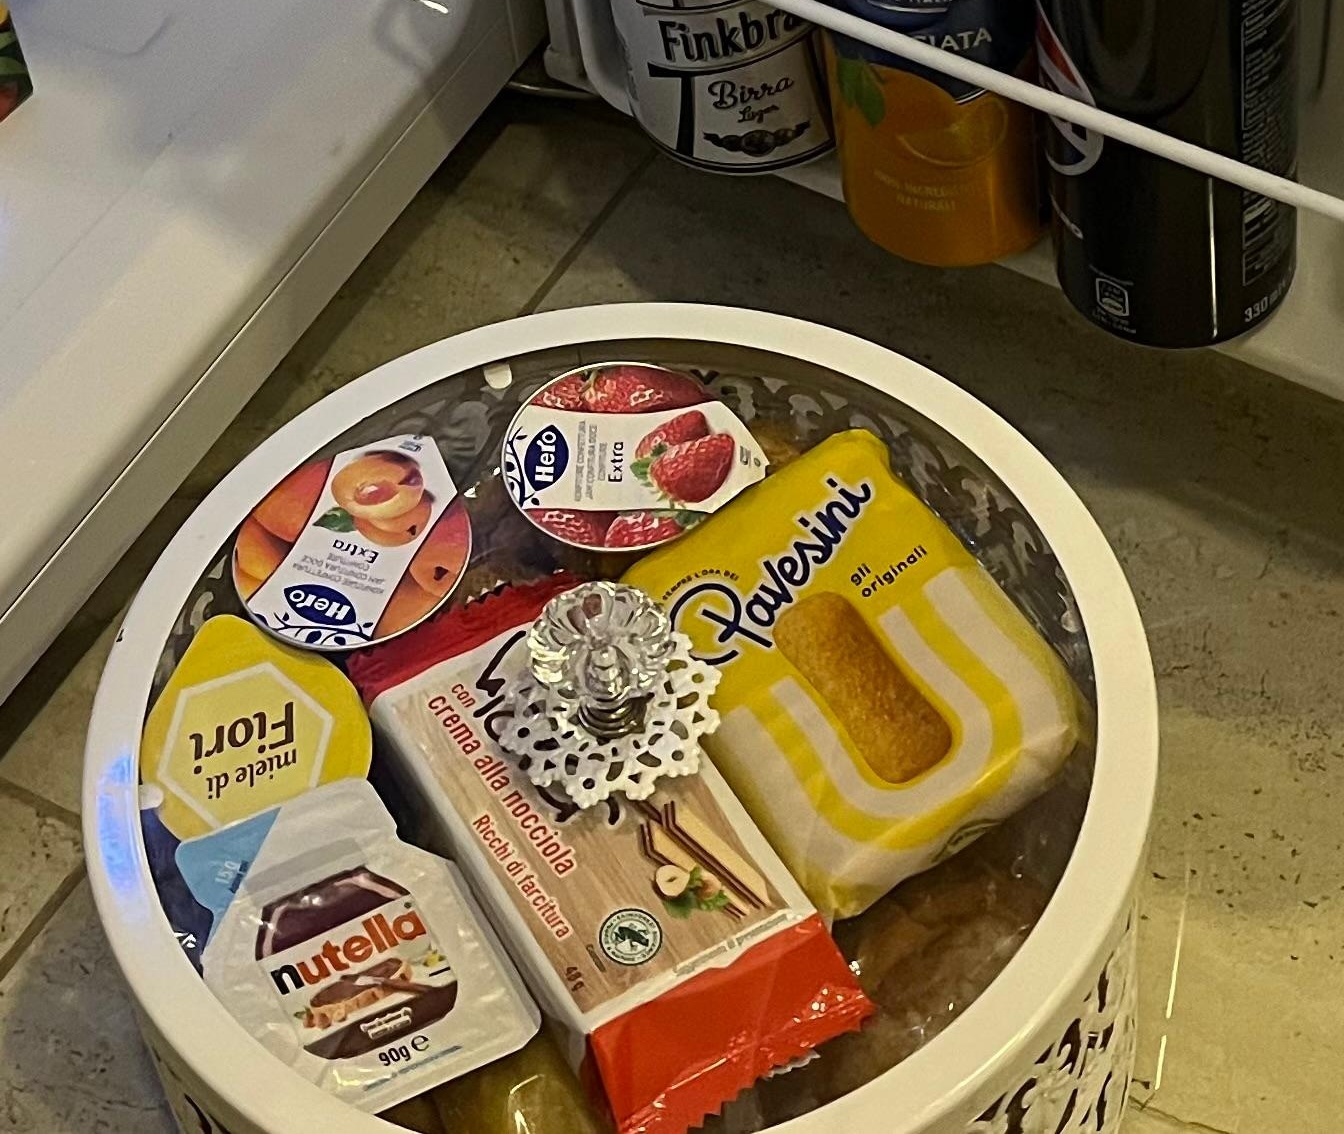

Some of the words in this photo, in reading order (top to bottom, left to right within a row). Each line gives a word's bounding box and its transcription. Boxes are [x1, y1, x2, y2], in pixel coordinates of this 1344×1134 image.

[707, 75, 796, 110] Birra
[1244, 296, 1269, 323] 330
[533, 429, 558, 484] Hero
[607, 440, 624, 484] Extra
[332, 538, 379, 564] Extra
[861, 544, 929, 598] originali
[669, 477, 872, 666] Pavesini
[850, 562, 872, 587] gli
[288, 589, 351, 621] Hero
[451, 682, 477, 709] con
[188, 701, 295, 776] Fiori
[205, 776, 230, 800] di
[234, 748, 298, 788] miele
[428, 695, 482, 755] crema
[474, 754, 511, 792] alla
[501, 788, 577, 878] nocciola
[471, 813, 513, 863] Ricchi
[505, 858, 525, 879] di
[516, 875, 571, 941] farcitura
[269, 908, 428, 996] nutella
[377, 1043, 413, 1068] 90g
